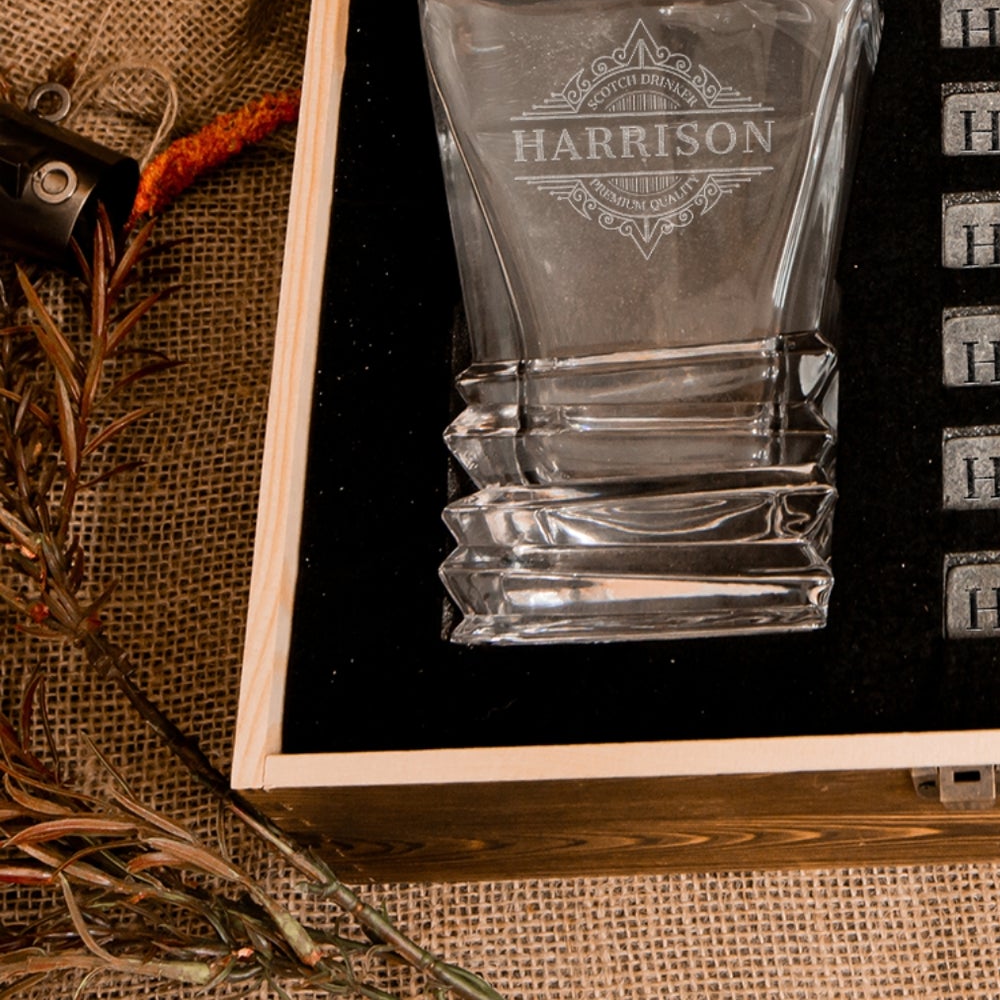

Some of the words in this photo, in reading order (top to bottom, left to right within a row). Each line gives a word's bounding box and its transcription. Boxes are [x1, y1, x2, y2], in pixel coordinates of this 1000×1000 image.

[957, 7, 1000, 48] H
[587, 74, 637, 111] SCOTCH
[640, 73, 700, 107] DRINKER
[512, 120, 775, 162] HARRISON
[590, 178, 646, 210] PREMIUM
[650, 175, 700, 211] QUALITY
